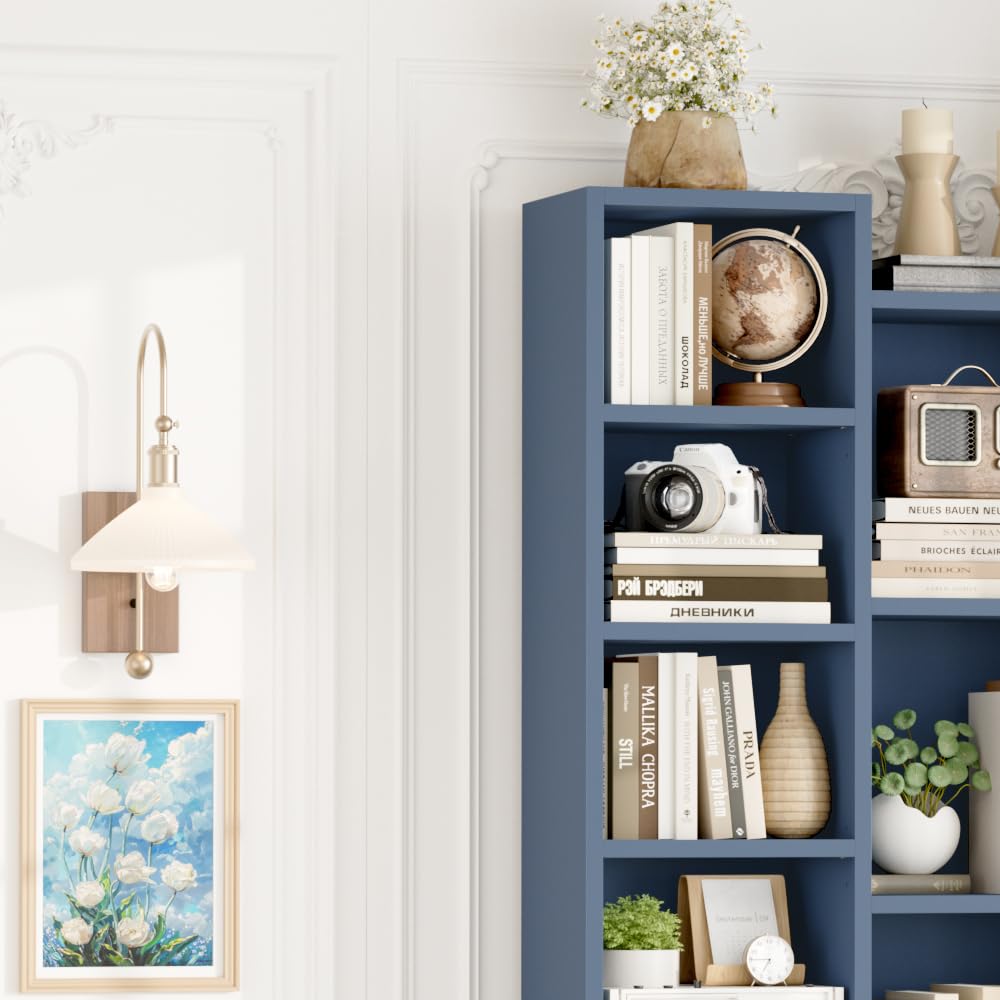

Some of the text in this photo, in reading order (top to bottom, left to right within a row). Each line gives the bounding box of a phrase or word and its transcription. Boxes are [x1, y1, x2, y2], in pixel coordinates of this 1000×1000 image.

[657, 265, 668, 385] ЗАБОТА О ПРЕДАННЫХ
[681, 336, 689, 389] ШОКОЛАД
[698, 355, 709, 391] ЛУЧШЕ
[908, 506, 942, 515] NEUES
[945, 506, 979, 515] BAUEN
[920, 547, 966, 555] BRIOCHES
[904, 566, 972, 574] PHAIDON
[617, 577, 704, 597] РЭЙ БРЭДБЕРИ
[670, 607, 755, 618] ДНЕВНИКИ
[702, 687, 717, 715] Sigrid
[722, 681, 733, 705] JOHN
[725, 707, 738, 753] GALLIANO
[619, 738, 634, 769] STILL
[641, 685, 656, 808] MALLIKA CHOPRA
[743, 730, 756, 779] PRADA
[730, 765, 741, 788] DIOR
